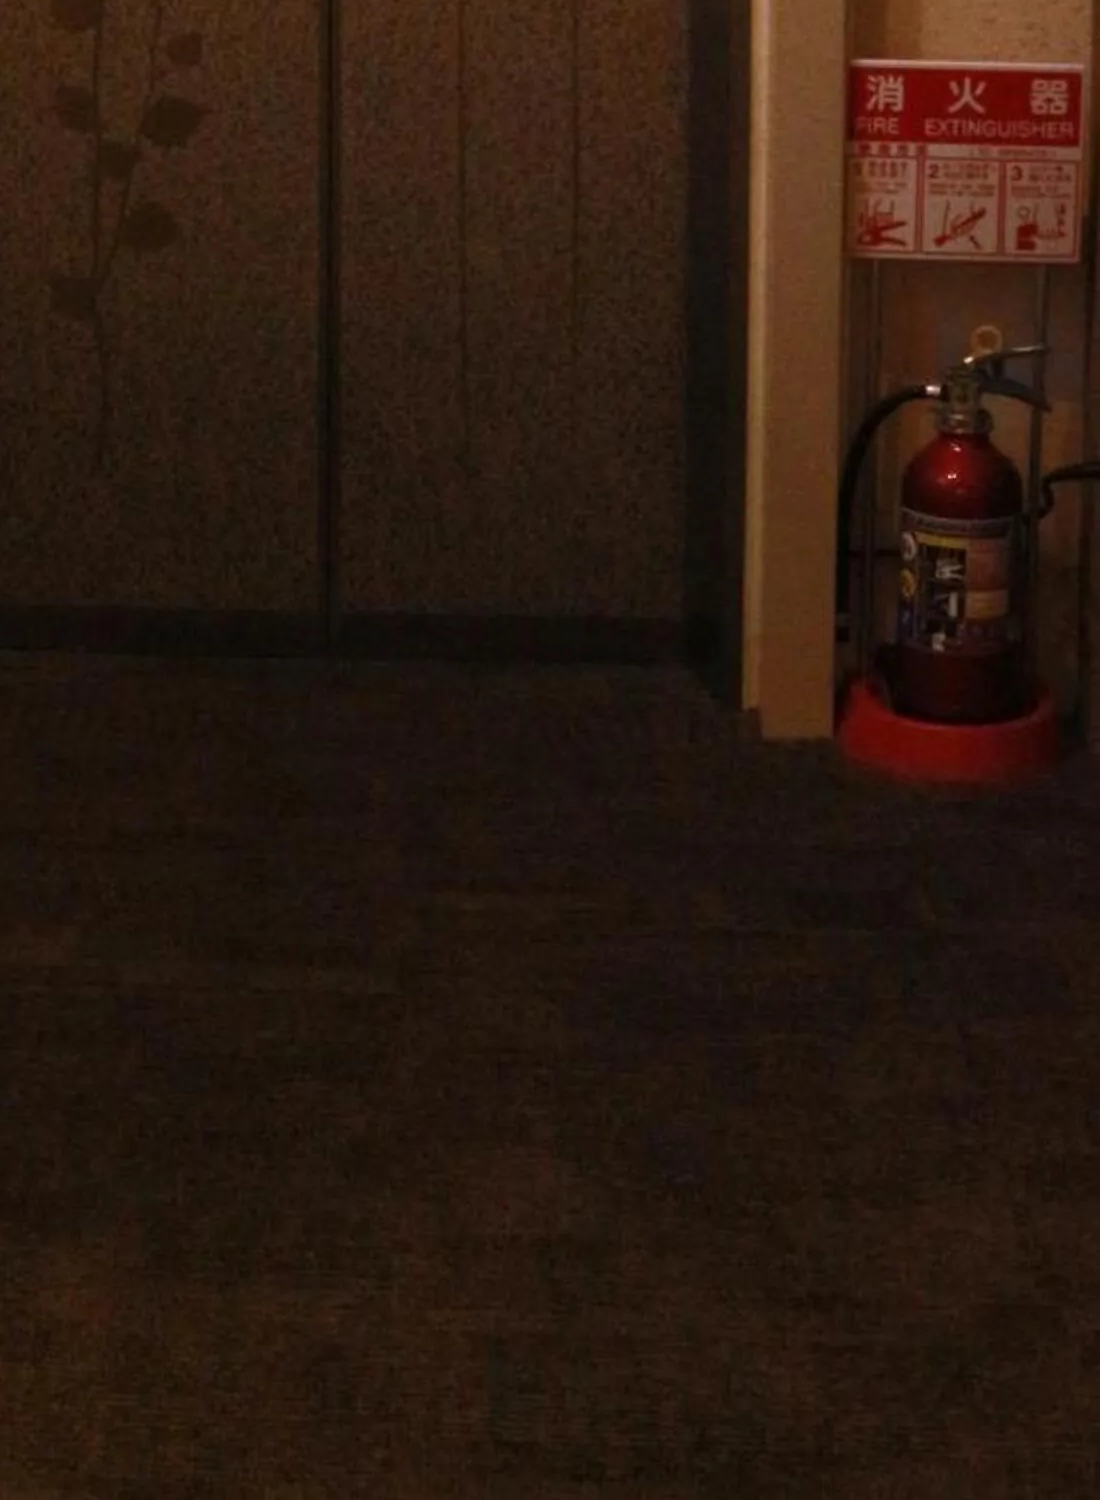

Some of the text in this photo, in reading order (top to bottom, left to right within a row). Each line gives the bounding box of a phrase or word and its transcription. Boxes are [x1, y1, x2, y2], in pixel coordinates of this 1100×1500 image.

[866, 74, 1069, 116] 消火器
[855, 116, 1075, 140] FIRE EXTINGUISHER
